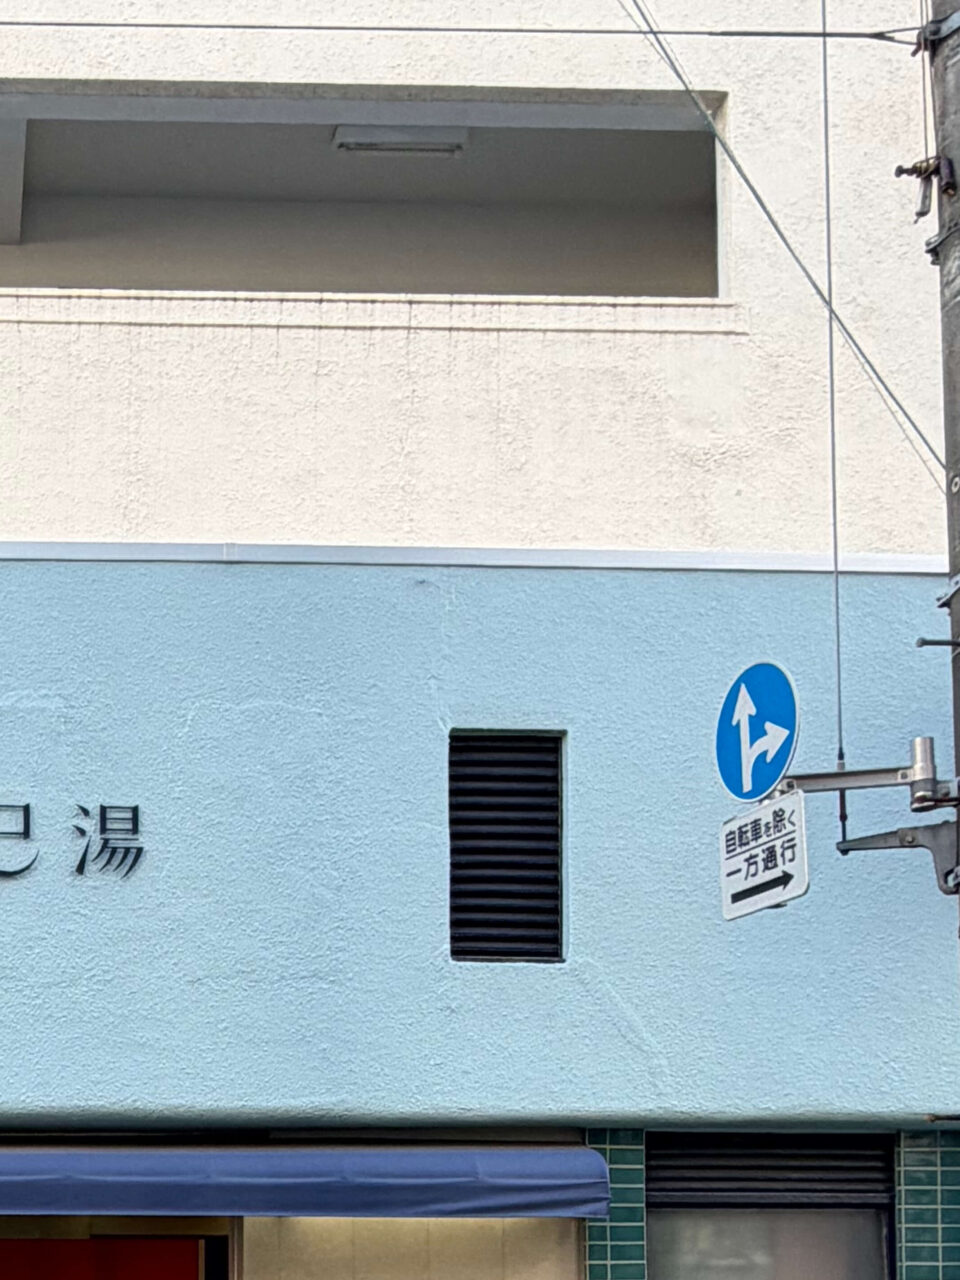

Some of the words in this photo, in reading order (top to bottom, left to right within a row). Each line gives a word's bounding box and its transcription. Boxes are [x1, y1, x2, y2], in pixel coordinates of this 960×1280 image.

[724, 807, 796, 854] 自転車を除く
[725, 836, 797, 881] 一方通行
